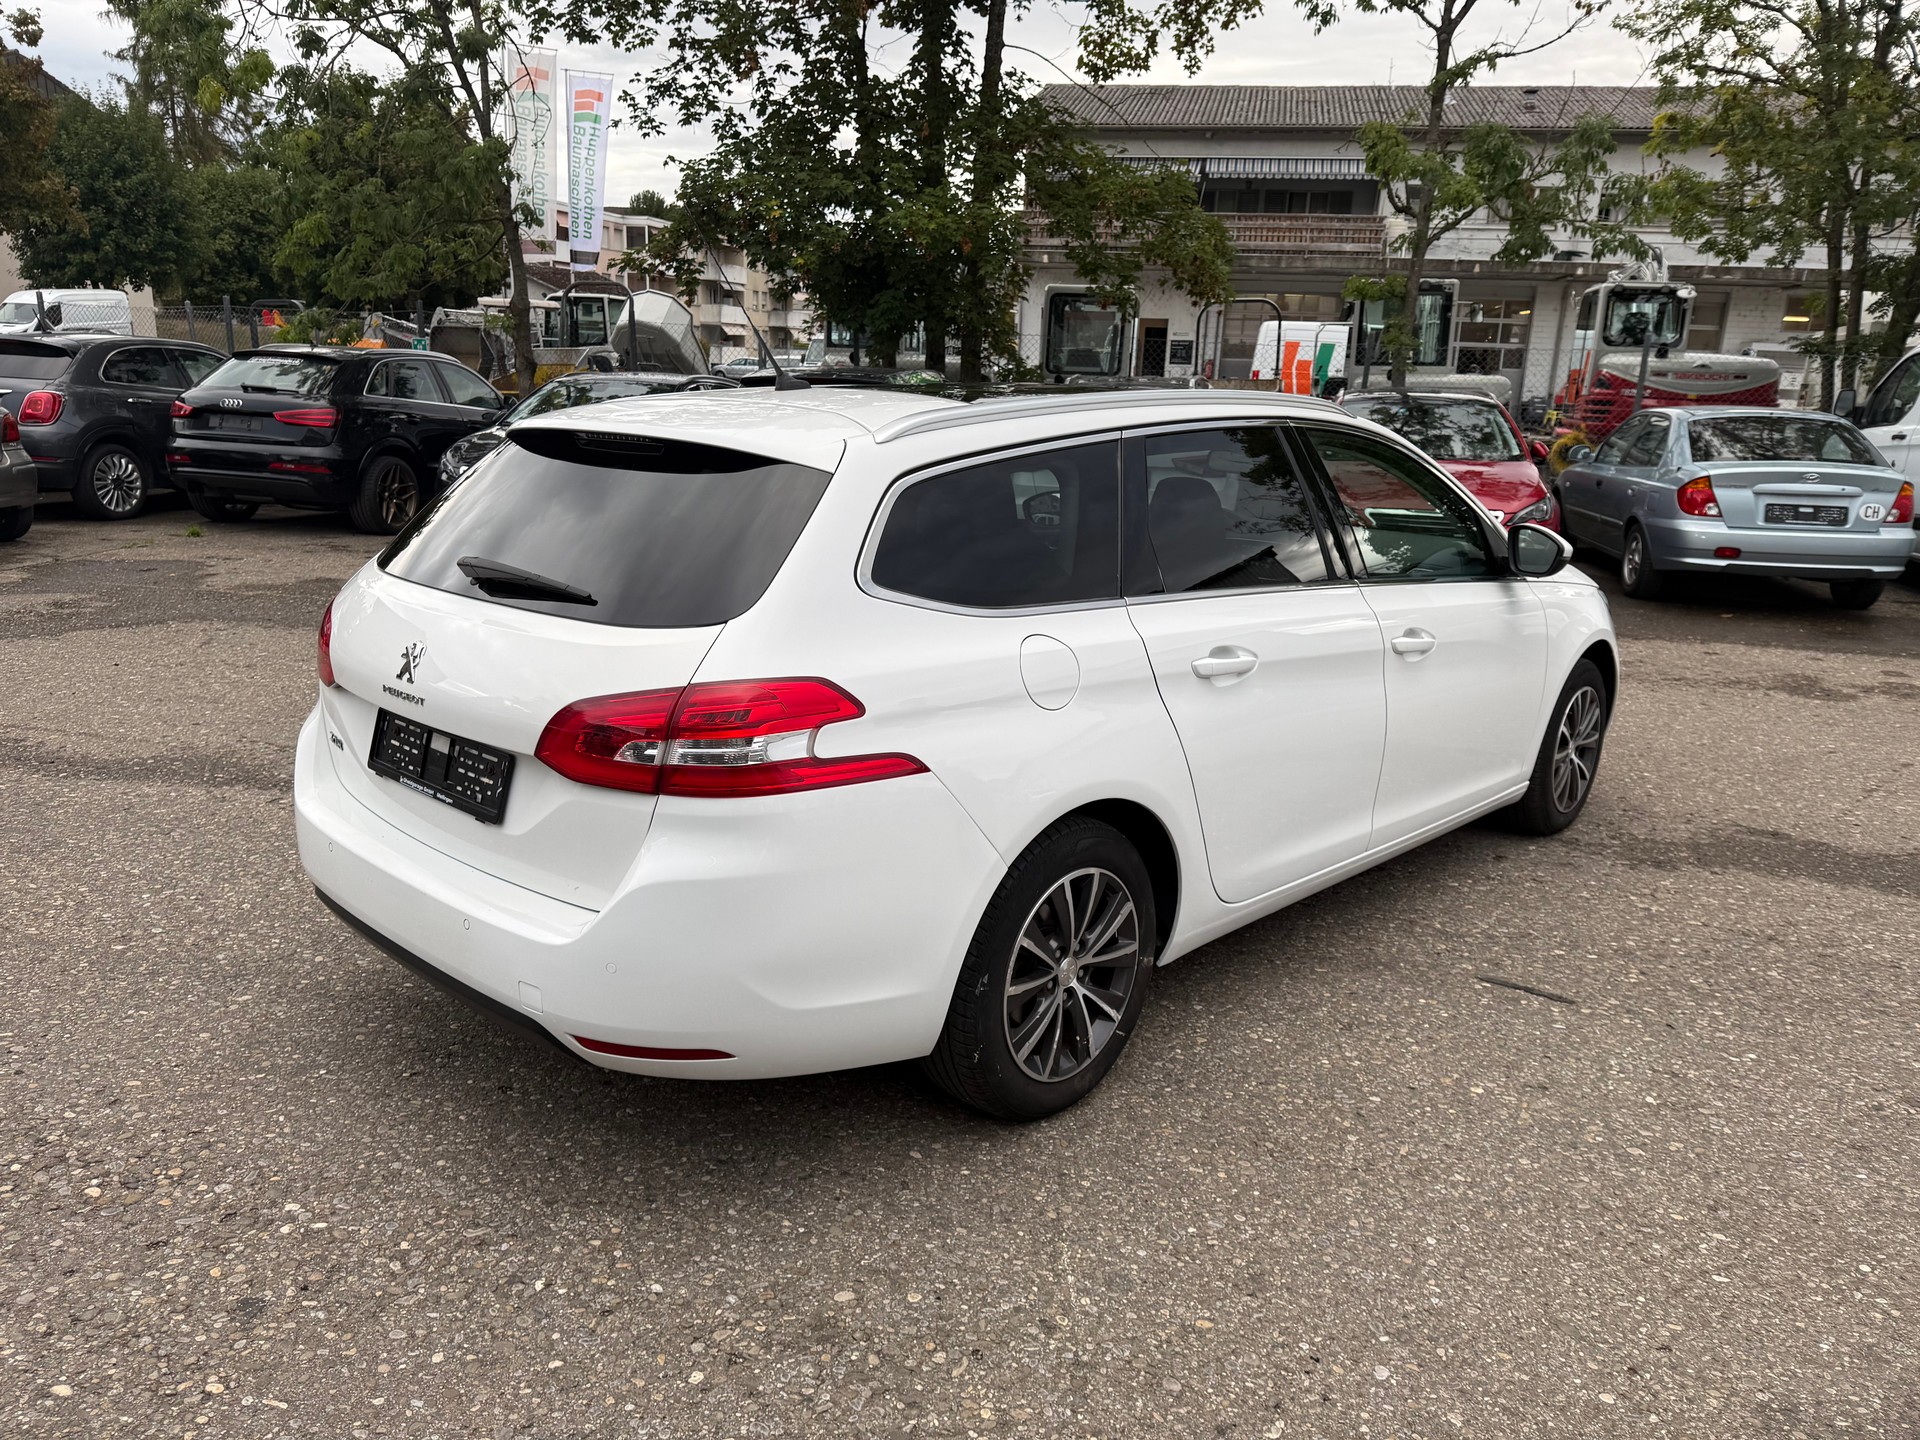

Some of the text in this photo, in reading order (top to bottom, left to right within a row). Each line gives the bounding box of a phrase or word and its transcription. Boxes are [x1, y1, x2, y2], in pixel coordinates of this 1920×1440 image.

[571, 124, 586, 239] Baumaschinen
[583, 126, 600, 240] Huppenkothen
[1865, 506, 1881, 519] CH
[382, 684, 426, 707] PEUGEOT
